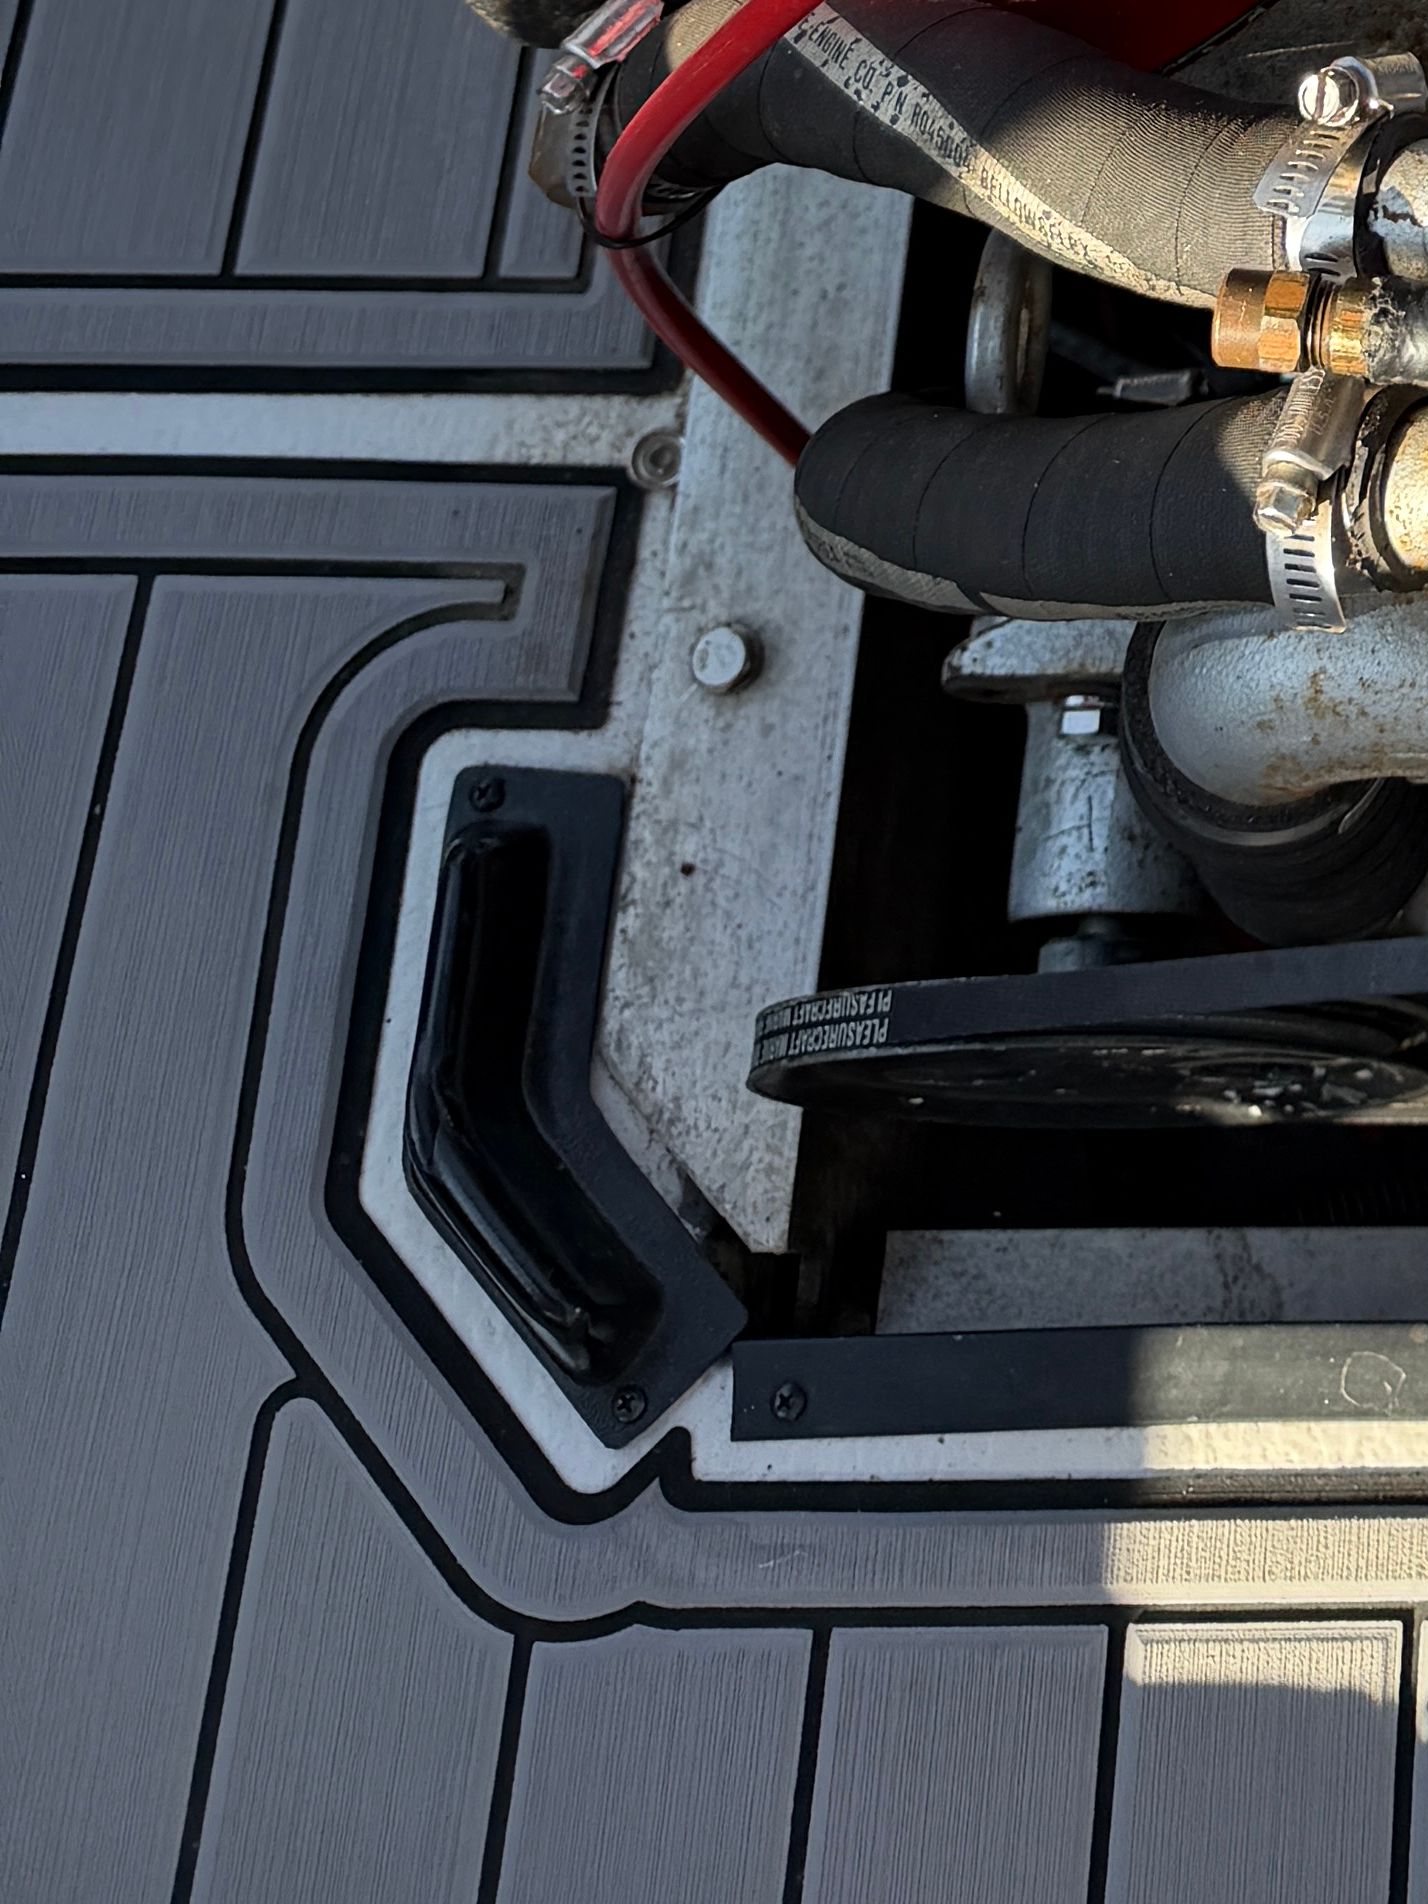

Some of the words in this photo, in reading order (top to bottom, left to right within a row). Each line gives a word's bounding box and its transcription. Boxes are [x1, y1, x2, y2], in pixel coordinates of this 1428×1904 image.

[806, 19, 856, 71] ENGINE
[850, 57, 884, 94] CO.
[792, 990, 893, 1026] PLEASURECRAFT
[788, 1017, 890, 1056] PLEASURECRAFT
